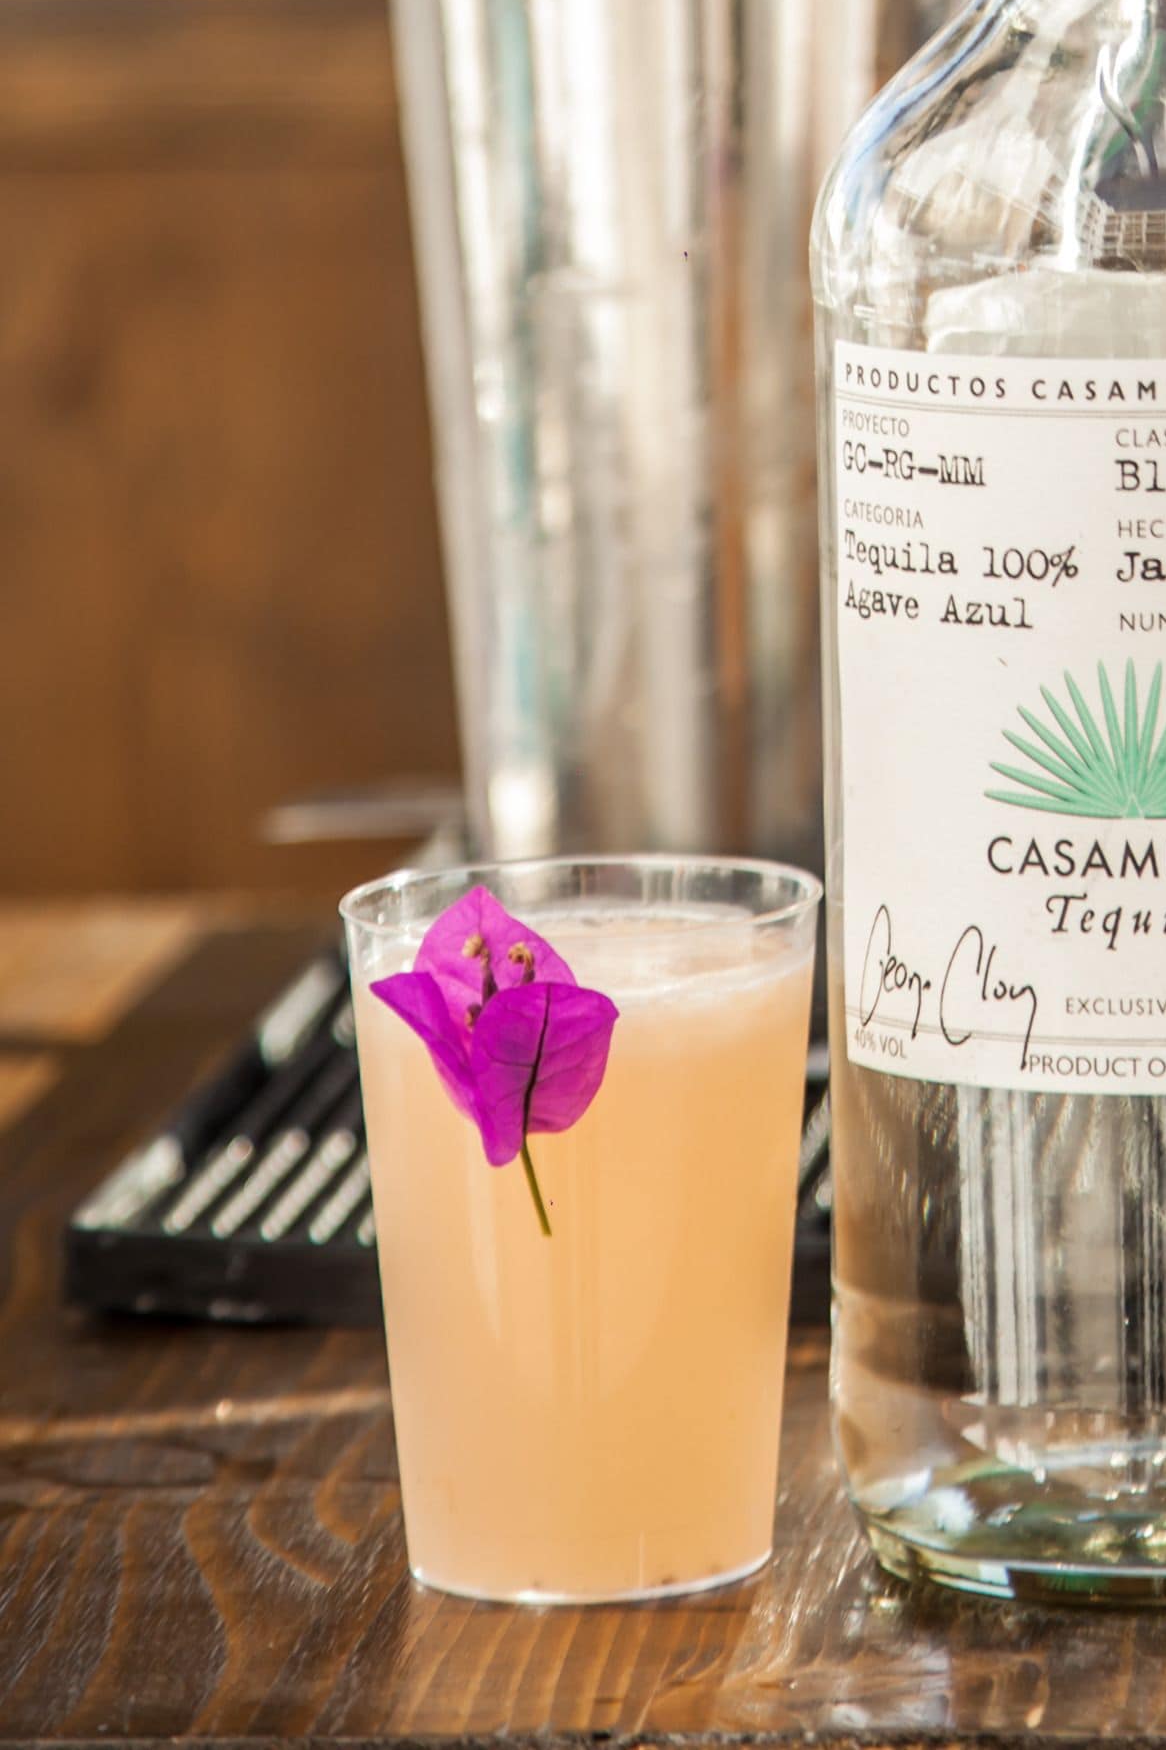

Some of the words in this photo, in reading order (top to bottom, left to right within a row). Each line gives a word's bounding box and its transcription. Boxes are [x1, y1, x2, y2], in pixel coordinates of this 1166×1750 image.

[845, 362, 1006, 399] PRODUCTOS
[842, 409, 910, 438] PROYECTO
[842, 440, 986, 487] GC-RG-MM
[844, 498, 924, 529] CATEGORIA
[844, 529, 958, 575] Tequila
[982, 545, 1079, 587] 100%
[844, 579, 920, 620] Agave
[940, 594, 1034, 628] Azul
[879, 1034, 907, 1059] VOL
[1028, 1053, 1143, 1077] PRODUCT
